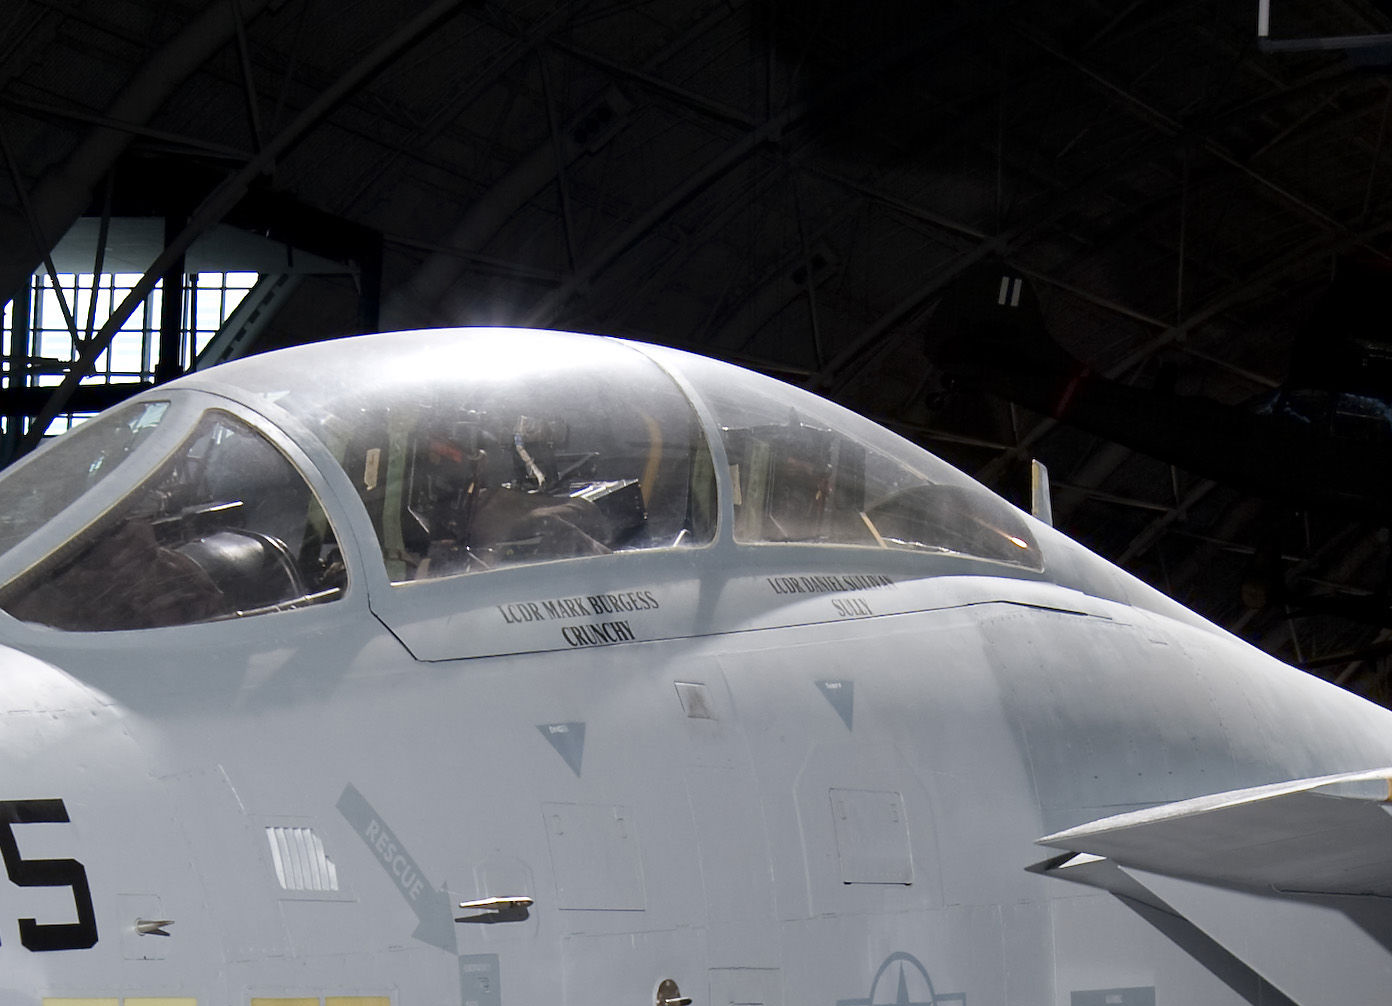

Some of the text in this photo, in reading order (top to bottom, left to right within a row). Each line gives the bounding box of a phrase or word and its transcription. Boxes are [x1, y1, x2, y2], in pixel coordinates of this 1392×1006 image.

[768, 577, 806, 594] LCDR
[800, 575, 849, 593] DANIEL
[497, 590, 660, 624] LCDR MARK BURGESS
[831, 599, 873, 617] SULLY
[561, 620, 636, 647] CRUNCHY
[366, 819, 424, 900] RESCUE
